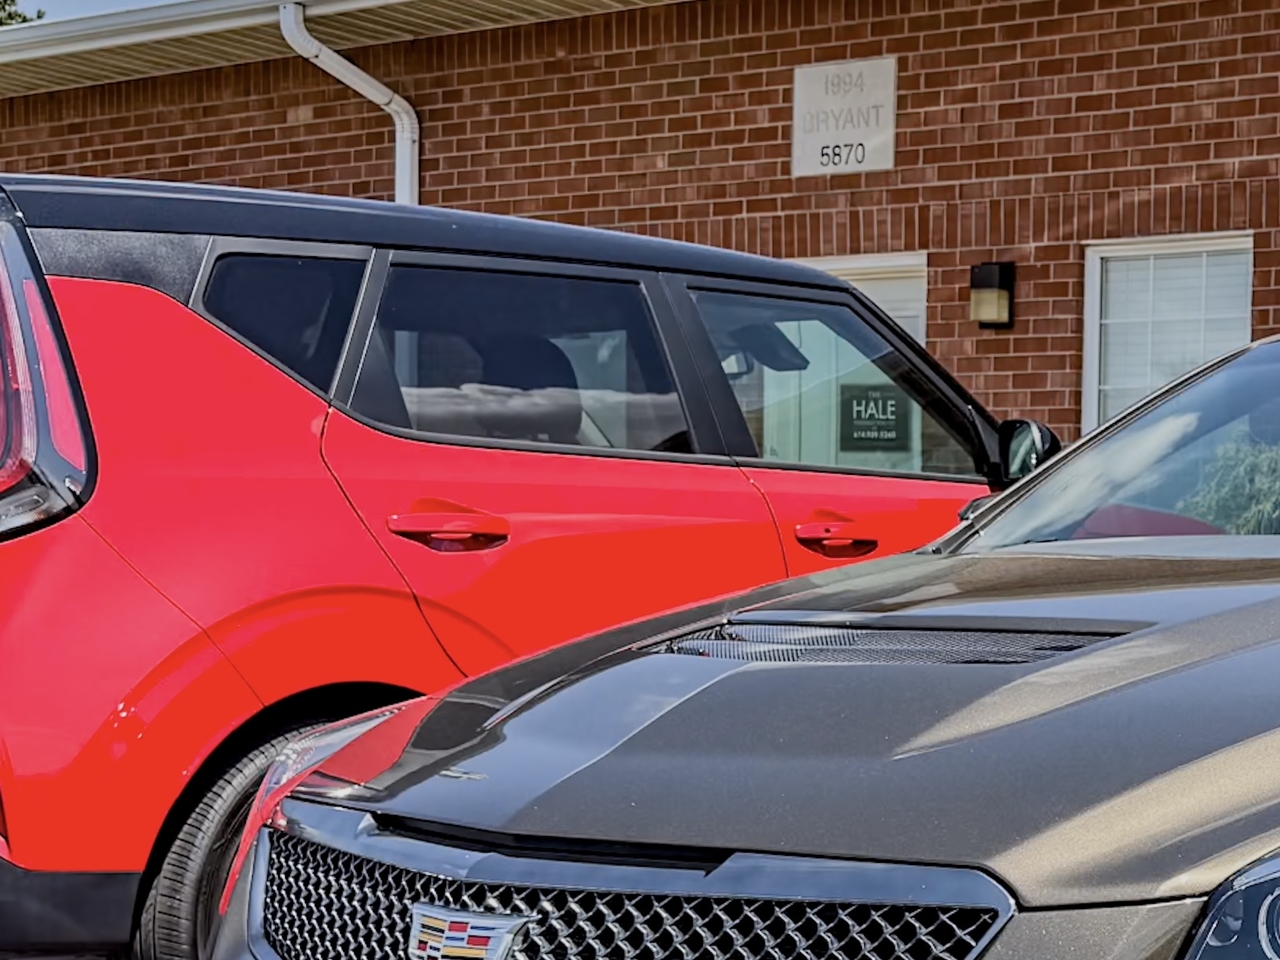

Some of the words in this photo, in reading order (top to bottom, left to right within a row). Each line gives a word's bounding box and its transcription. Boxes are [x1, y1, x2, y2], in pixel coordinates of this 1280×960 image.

[824, 70, 867, 96] 1994
[803, 104, 885, 134] BRYANT
[820, 142, 866, 167] 5870
[852, 399, 896, 419] HALE
